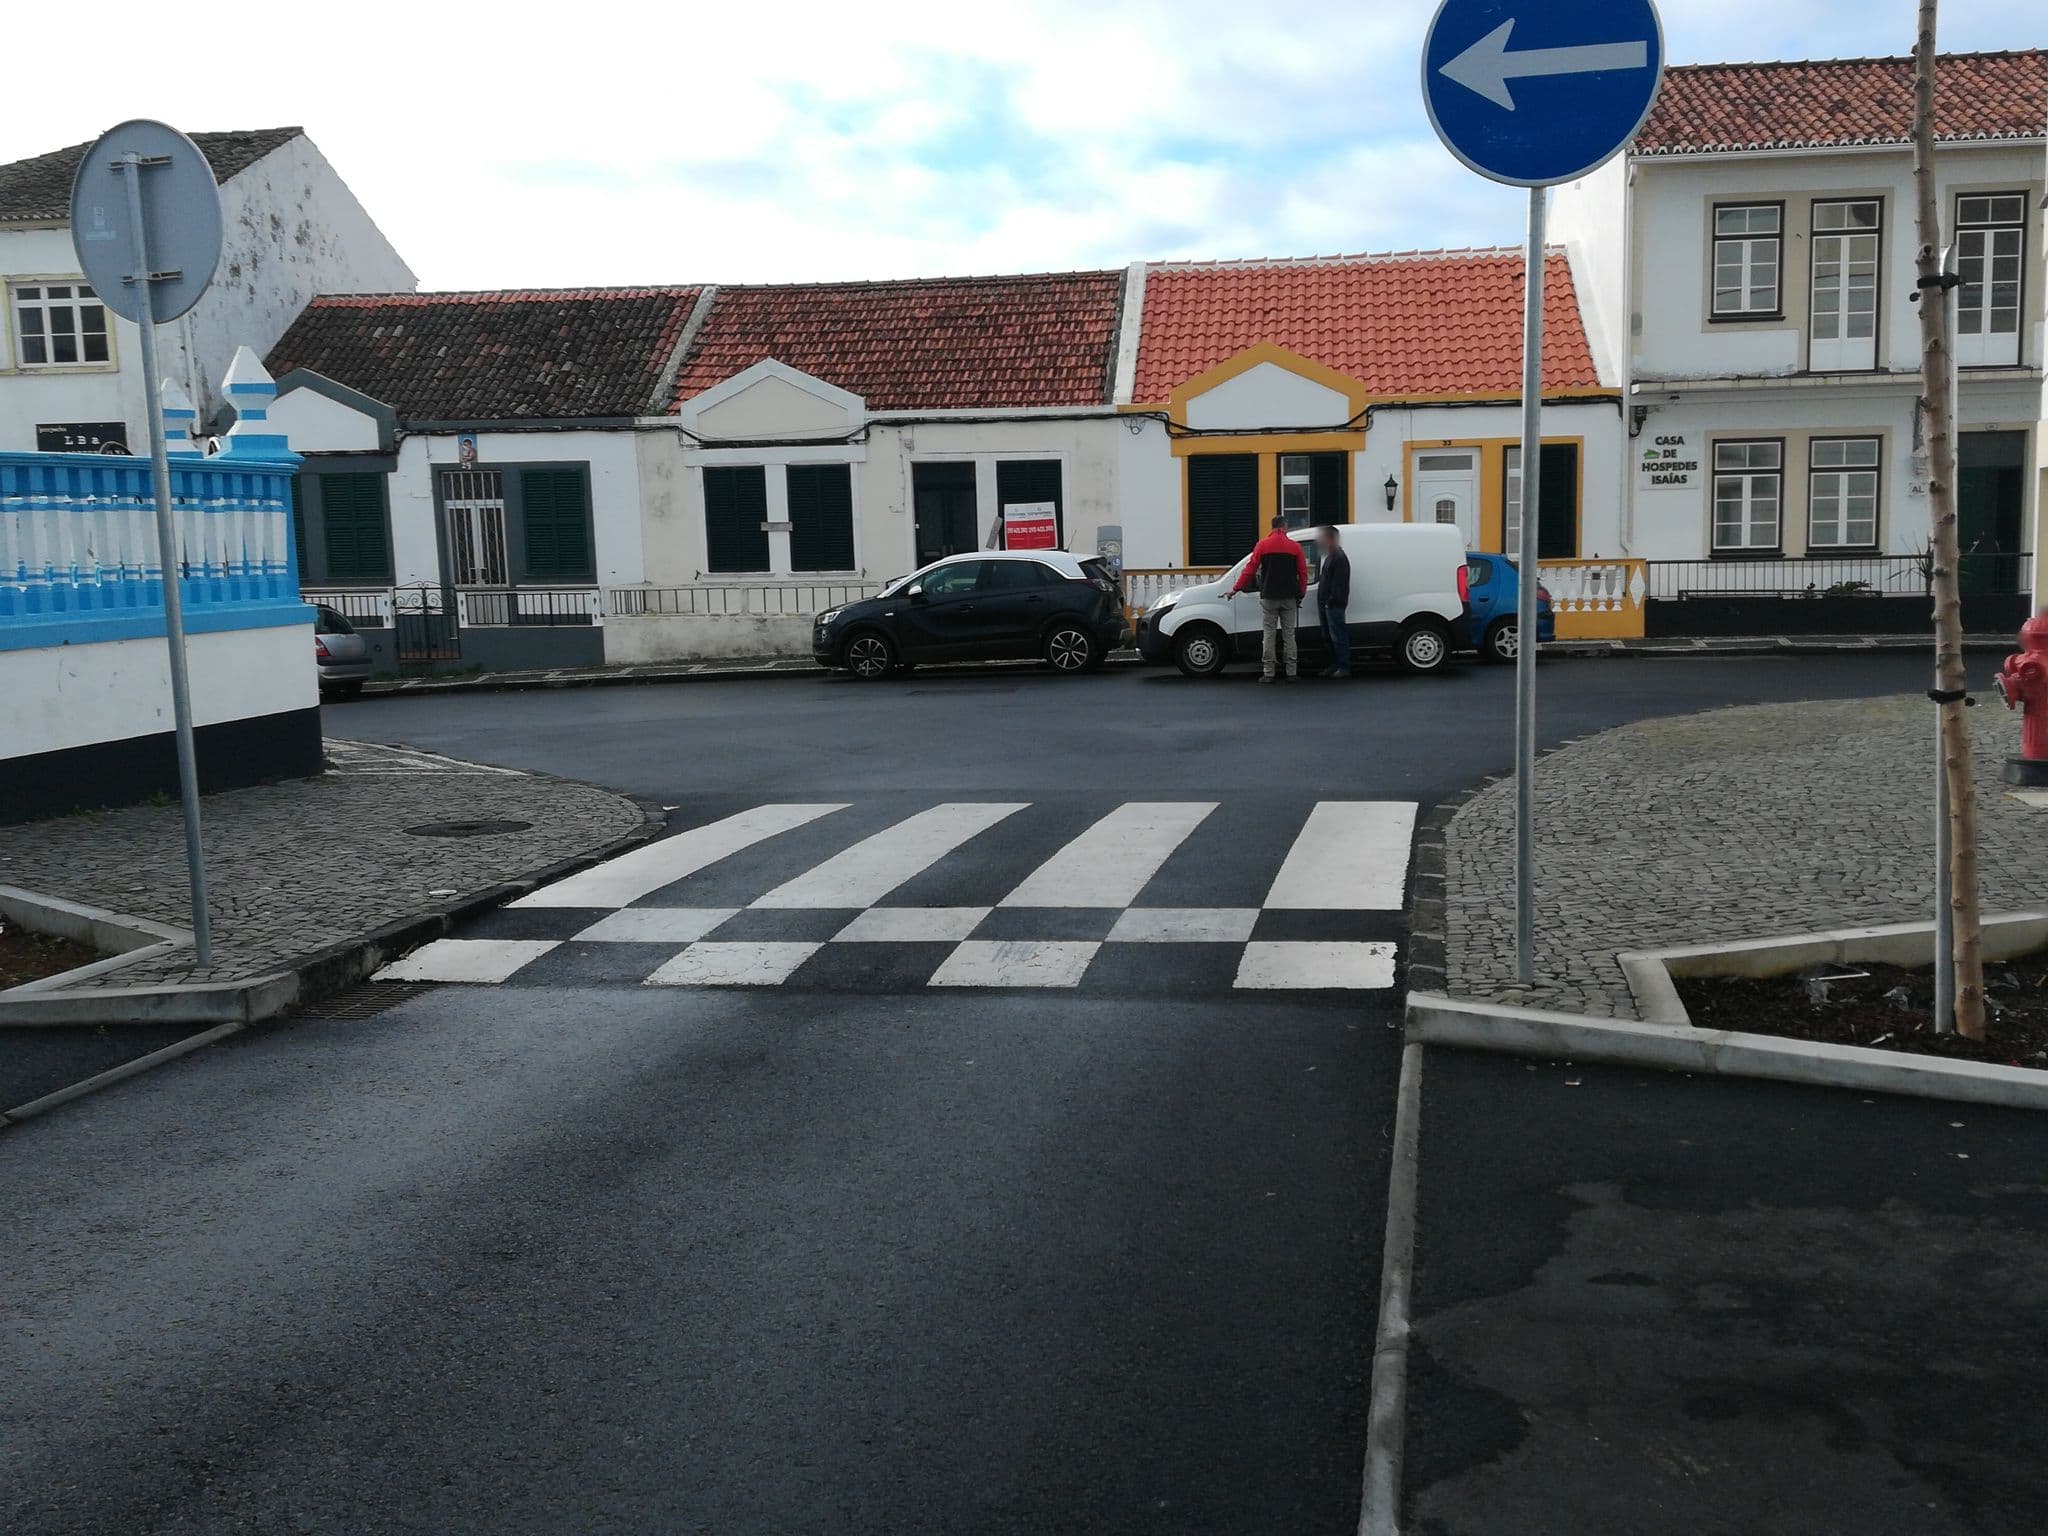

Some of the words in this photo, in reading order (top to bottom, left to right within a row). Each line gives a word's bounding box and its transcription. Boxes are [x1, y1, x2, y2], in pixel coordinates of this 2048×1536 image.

[1655, 435, 1685, 446] CASA
[1662, 448, 1677, 459] DE
[1641, 461, 1698, 472] HOSPEDES
[1651, 472, 1688, 485] ISAÍAS
[1911, 485, 1925, 494] AL
